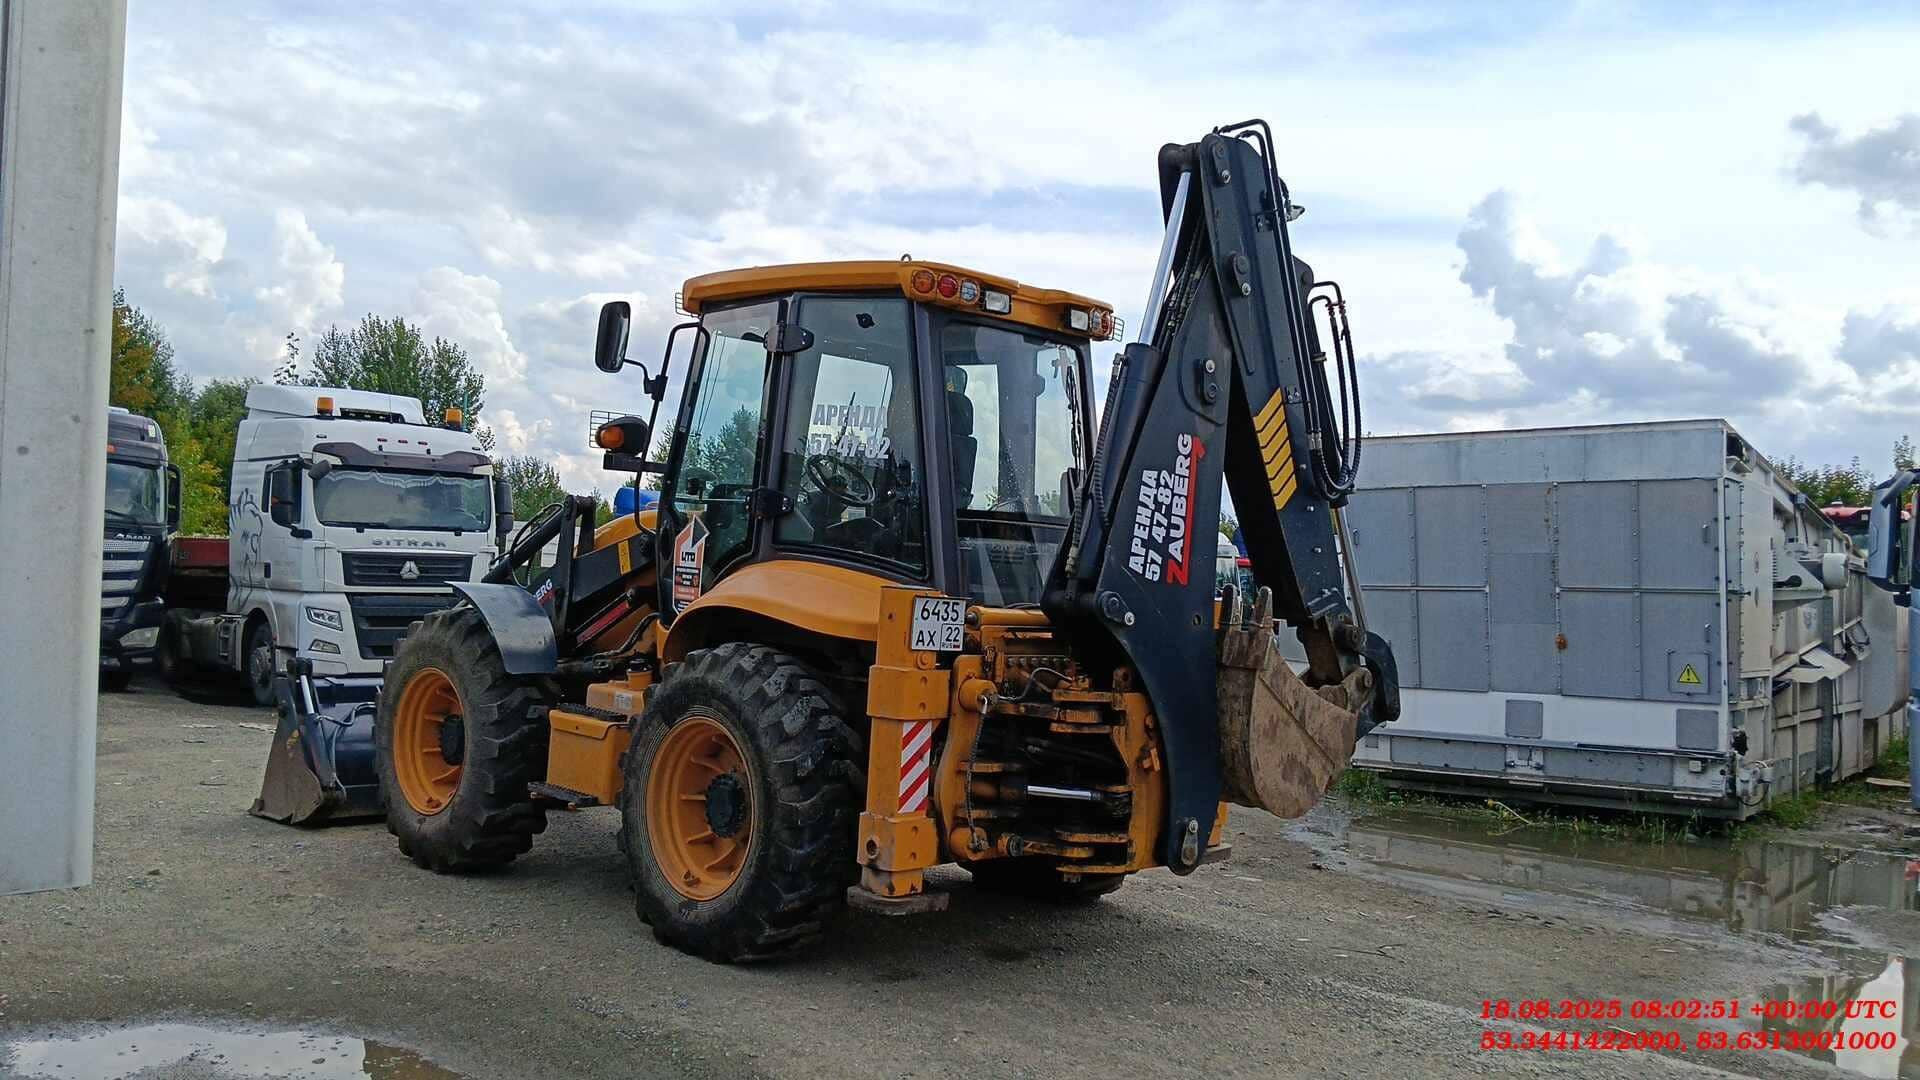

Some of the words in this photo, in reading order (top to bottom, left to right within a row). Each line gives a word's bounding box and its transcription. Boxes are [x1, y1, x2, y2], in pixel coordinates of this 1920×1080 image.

[812, 404, 888, 431] АРЕНДА
[1128, 469, 1159, 575] АРЕНДА
[1152, 470, 1174, 545] 47-82
[1166, 432, 1206, 586] ZAUBERG
[1145, 551, 1162, 582] 57
[920, 600, 960, 622] 6435
[945, 626, 960, 643] 22
